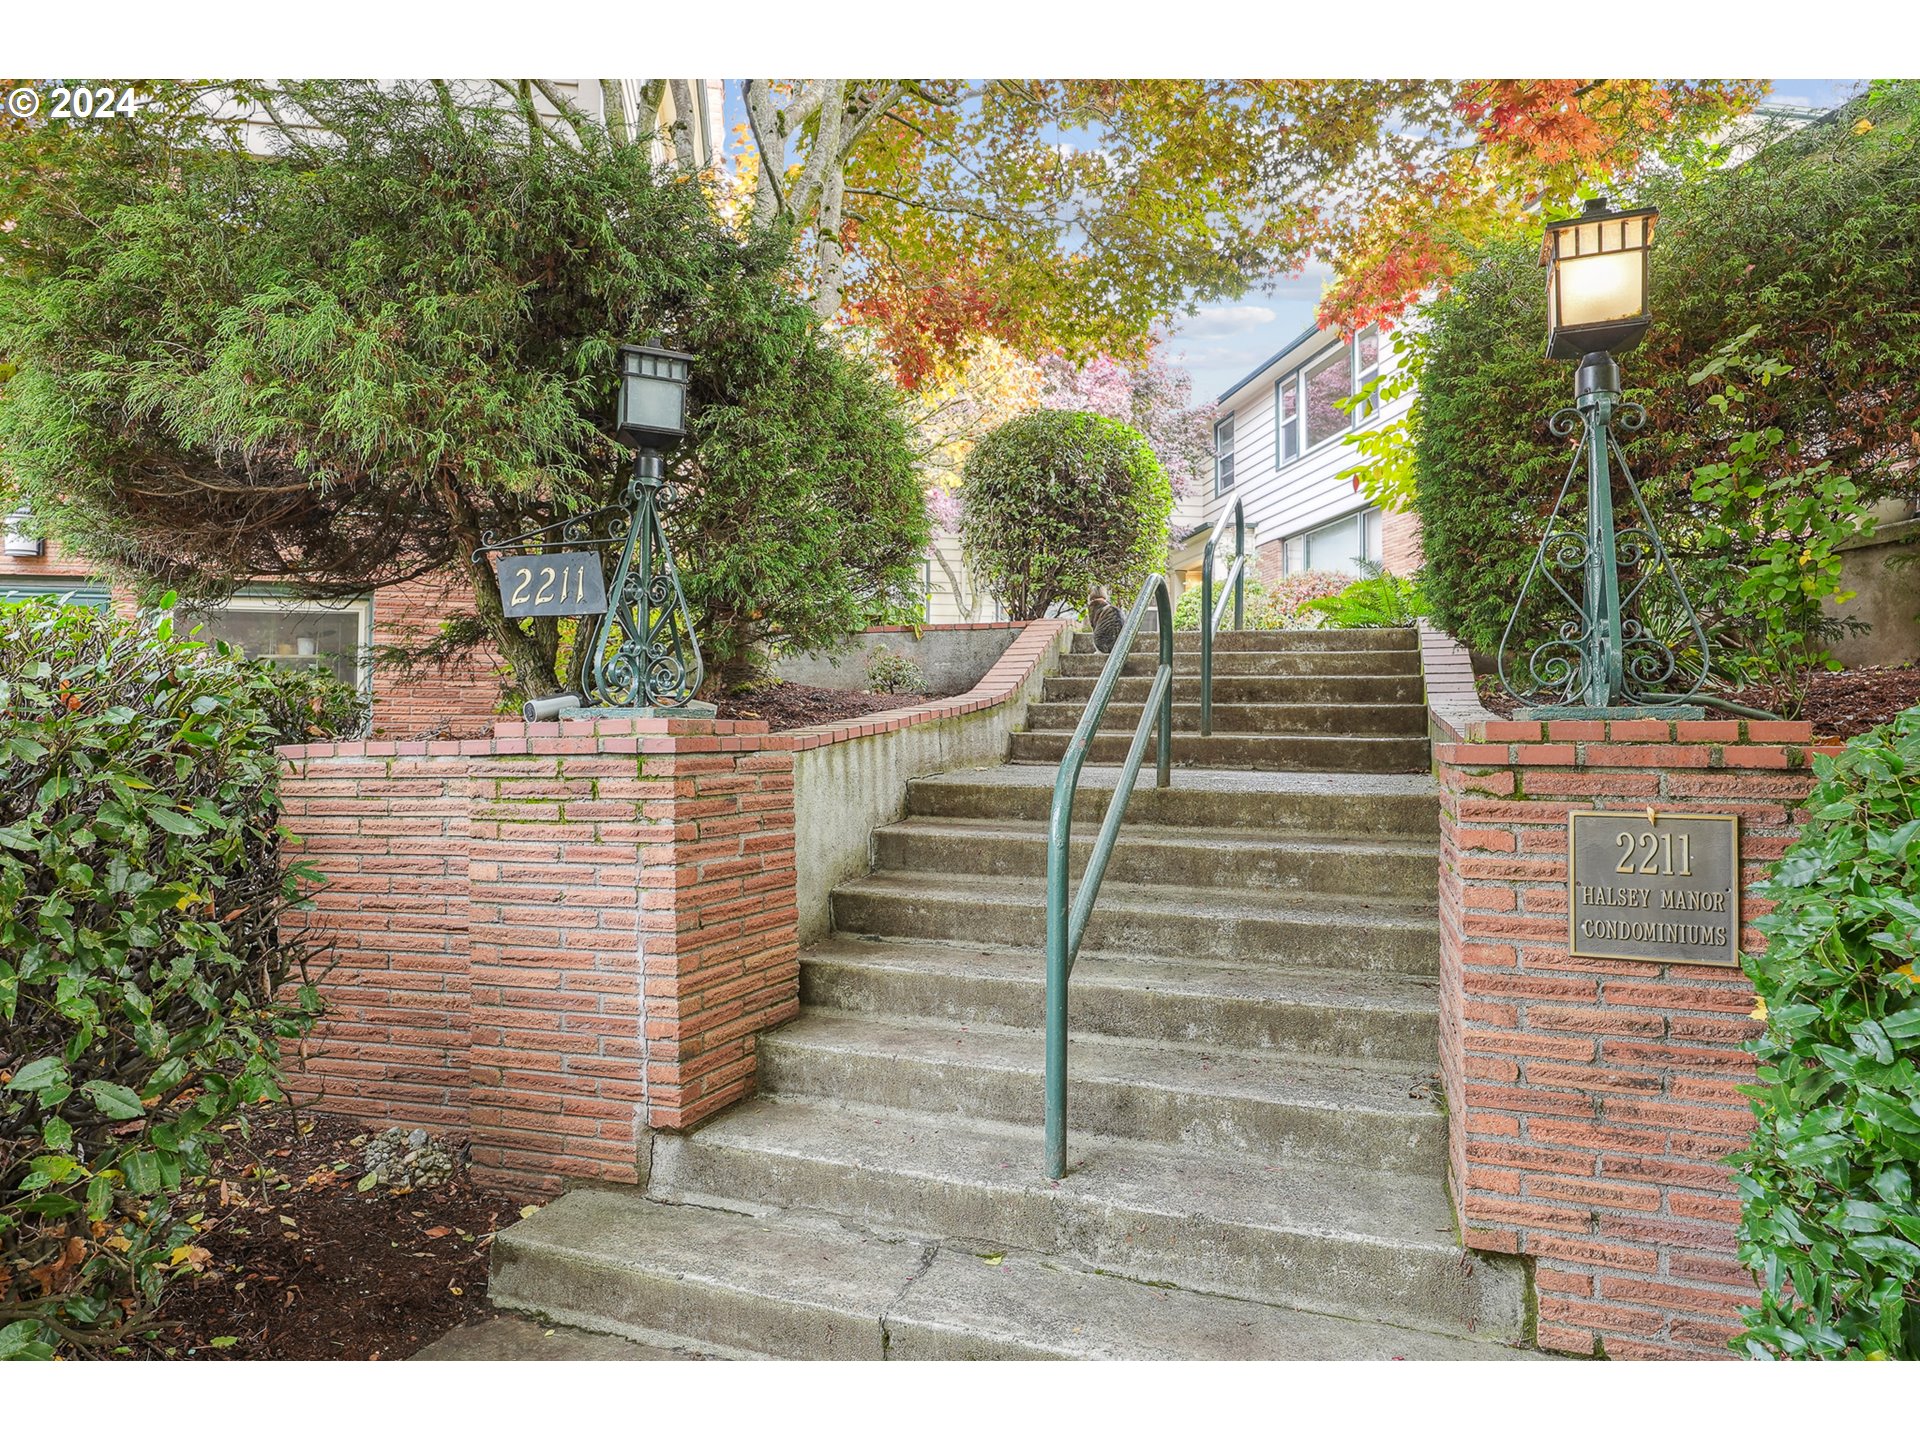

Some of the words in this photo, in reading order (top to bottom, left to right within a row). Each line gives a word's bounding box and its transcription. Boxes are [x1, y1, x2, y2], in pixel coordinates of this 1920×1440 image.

[511, 566, 584, 607] 2211
[1615, 831, 1692, 876] 2211
[1583, 886, 1651, 908] HALSEY
[1660, 890, 1725, 912] MANOR
[1584, 919, 1727, 946] CONDOMINIUMS
